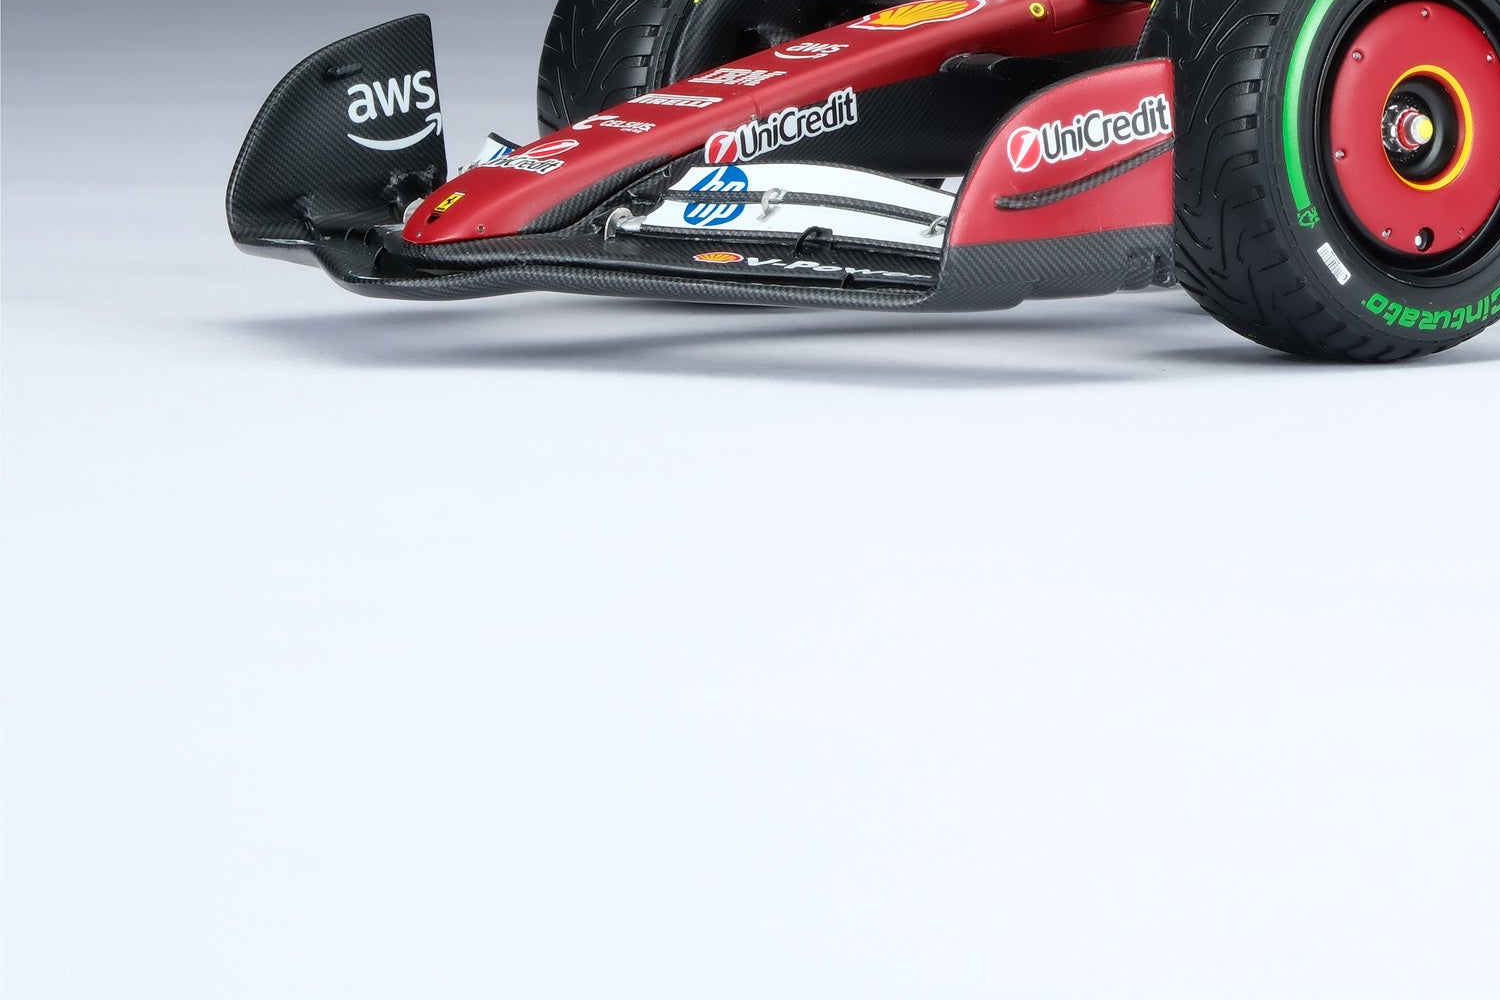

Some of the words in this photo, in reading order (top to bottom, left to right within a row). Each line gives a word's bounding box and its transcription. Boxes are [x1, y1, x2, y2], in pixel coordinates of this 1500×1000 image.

[785, 42, 849, 54] aws
[688, 67, 787, 87] IBM
[347, 70, 436, 124] aws
[627, 93, 723, 108] PIRELLI
[739, 91, 855, 158] UniCredit
[1041, 96, 1170, 160] UniCredit
[746, 256, 933, 279] V-Power
